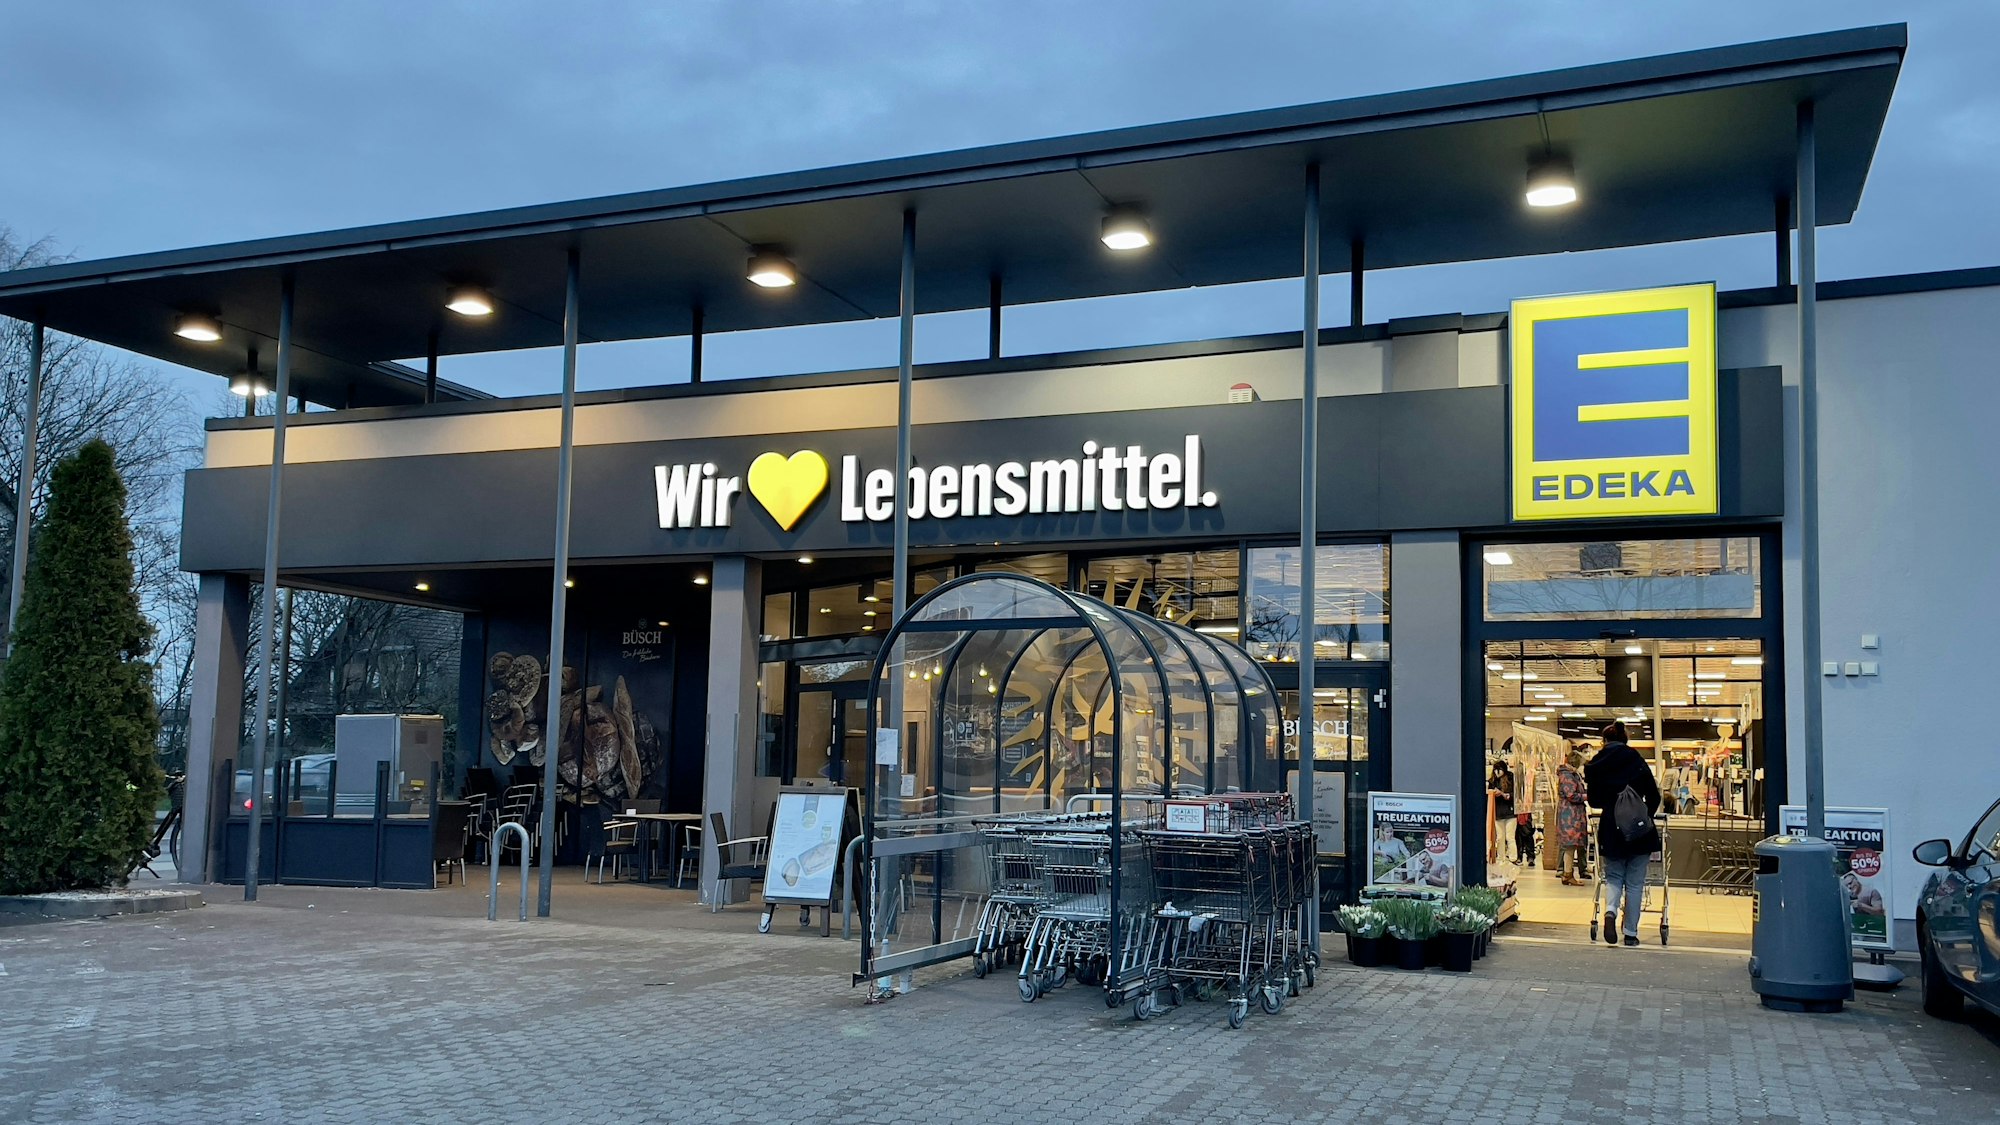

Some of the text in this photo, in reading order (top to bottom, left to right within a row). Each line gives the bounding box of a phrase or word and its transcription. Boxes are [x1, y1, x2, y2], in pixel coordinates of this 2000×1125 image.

[655, 434, 1217, 529] Wir Lebensmittel.
[1533, 469, 1695, 501] EDEKA
[623, 630, 662, 645] BÜSCH
[1626, 671, 1638, 693] 1
[1376, 812, 1450, 824] TREUEAKTION
[1790, 828, 1881, 842] TREAKTION
